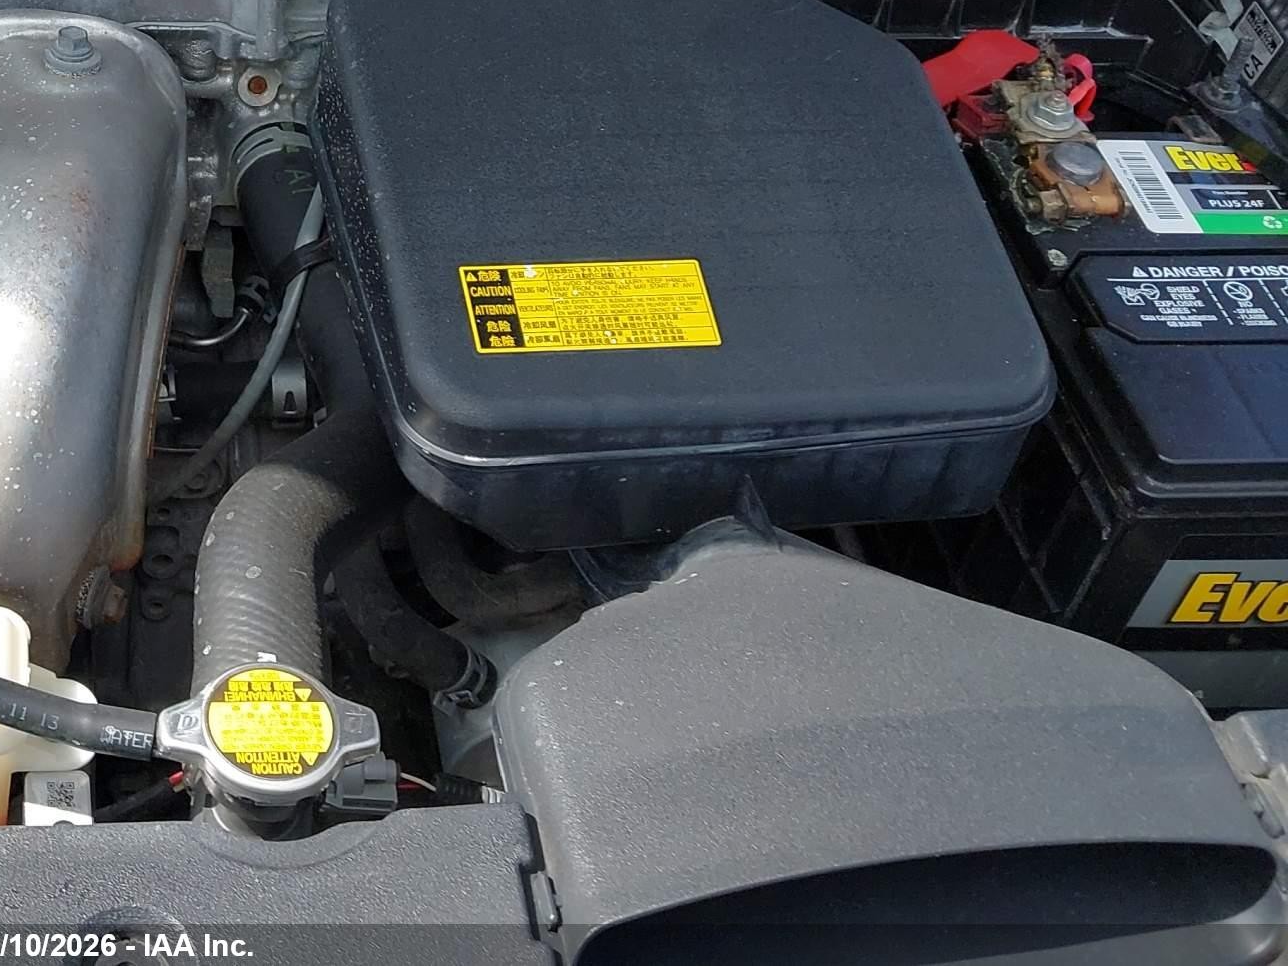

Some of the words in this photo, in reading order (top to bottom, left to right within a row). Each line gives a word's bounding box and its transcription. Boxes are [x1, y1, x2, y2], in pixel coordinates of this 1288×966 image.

[1208, 199, 1242, 209] PLUS
[1244, 199, 1265, 209] 24F
[1148, 266, 1223, 278] DANGER
[470, 285, 512, 297] CAUTION
[1166, 286, 1200, 294] SHIELD
[474, 304, 517, 316] ATTENTION
[1154, 300, 1206, 308] EXPLOSIVE
[223, 691, 296, 702] ВНИМАНИЕ!
[9, 703, 29, 721] 11
[40, 712, 60, 731] 13
[99, 725, 153, 749] WATER
[236, 752, 302, 764] ATTENTION
[251, 762, 303, 775] CAUTION
